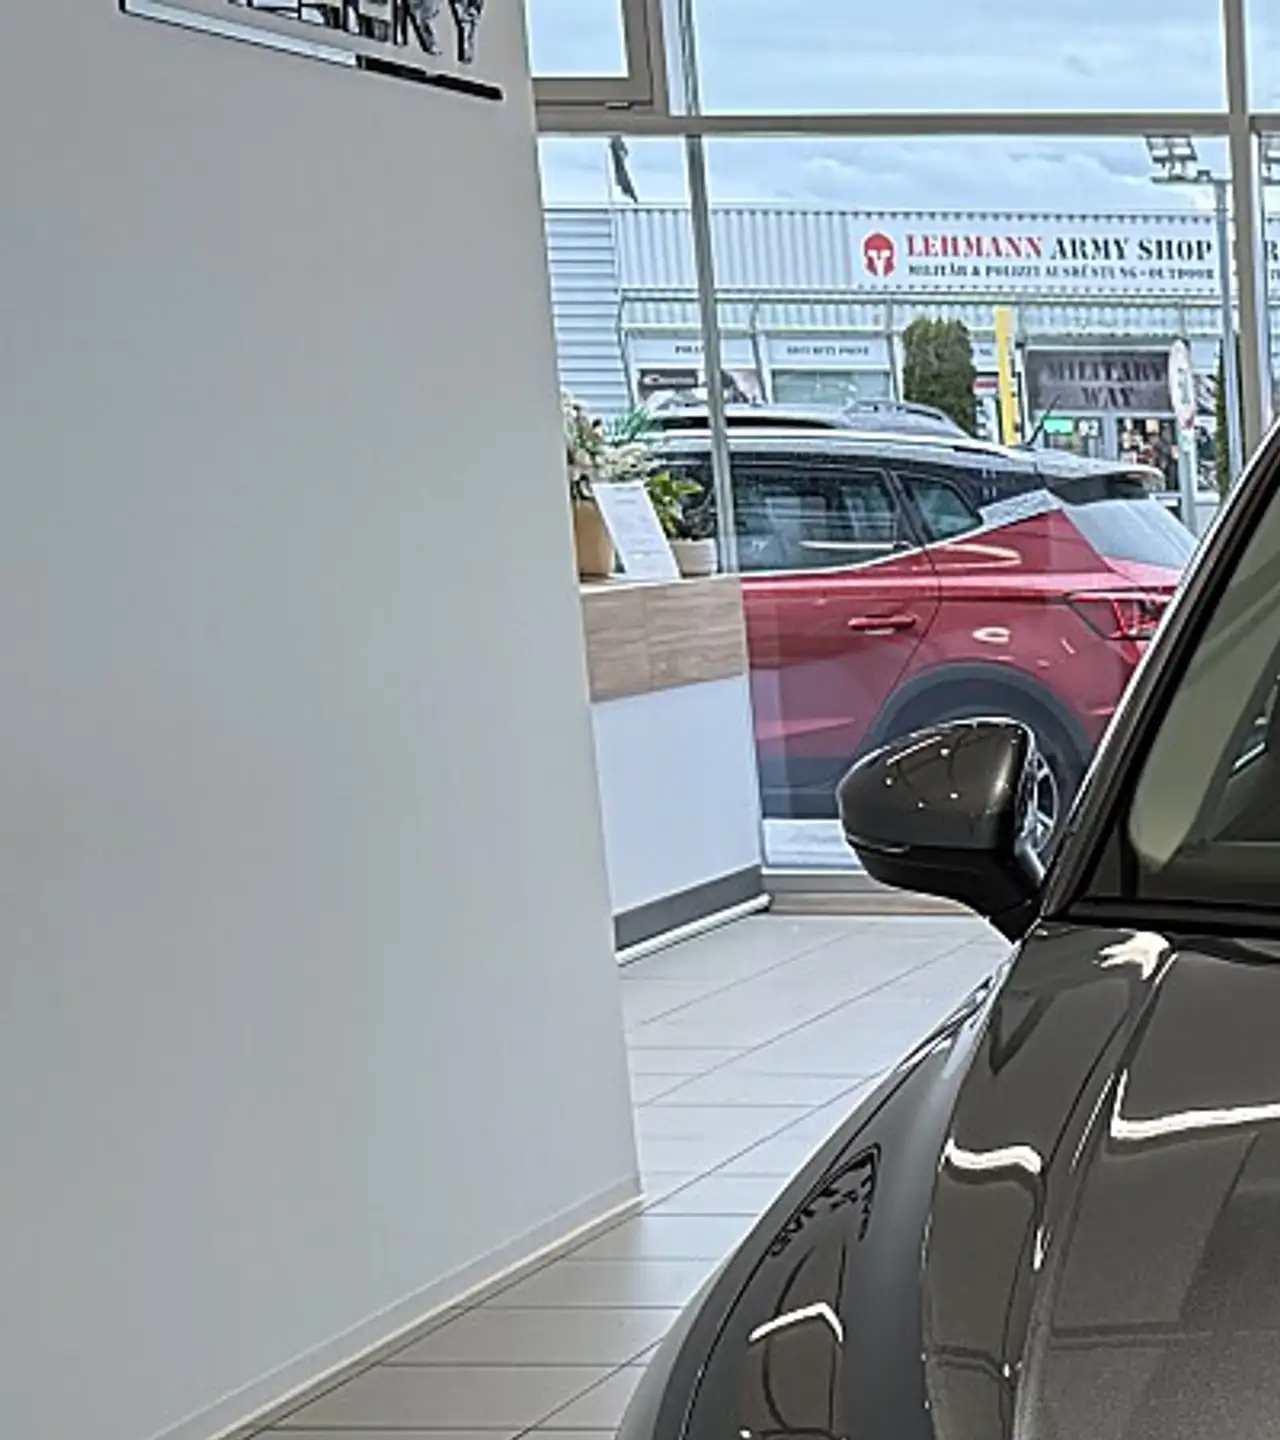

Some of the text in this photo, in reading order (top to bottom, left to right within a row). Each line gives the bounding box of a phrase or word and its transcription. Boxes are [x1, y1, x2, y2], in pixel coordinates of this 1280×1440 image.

[906, 234, 1042, 258] LEHMANN
[1050, 237, 1129, 260] ARMY
[1137, 239, 1212, 261] SHOP
[1049, 360, 1164, 382] MILITARY
[1081, 386, 1136, 407] WAY
